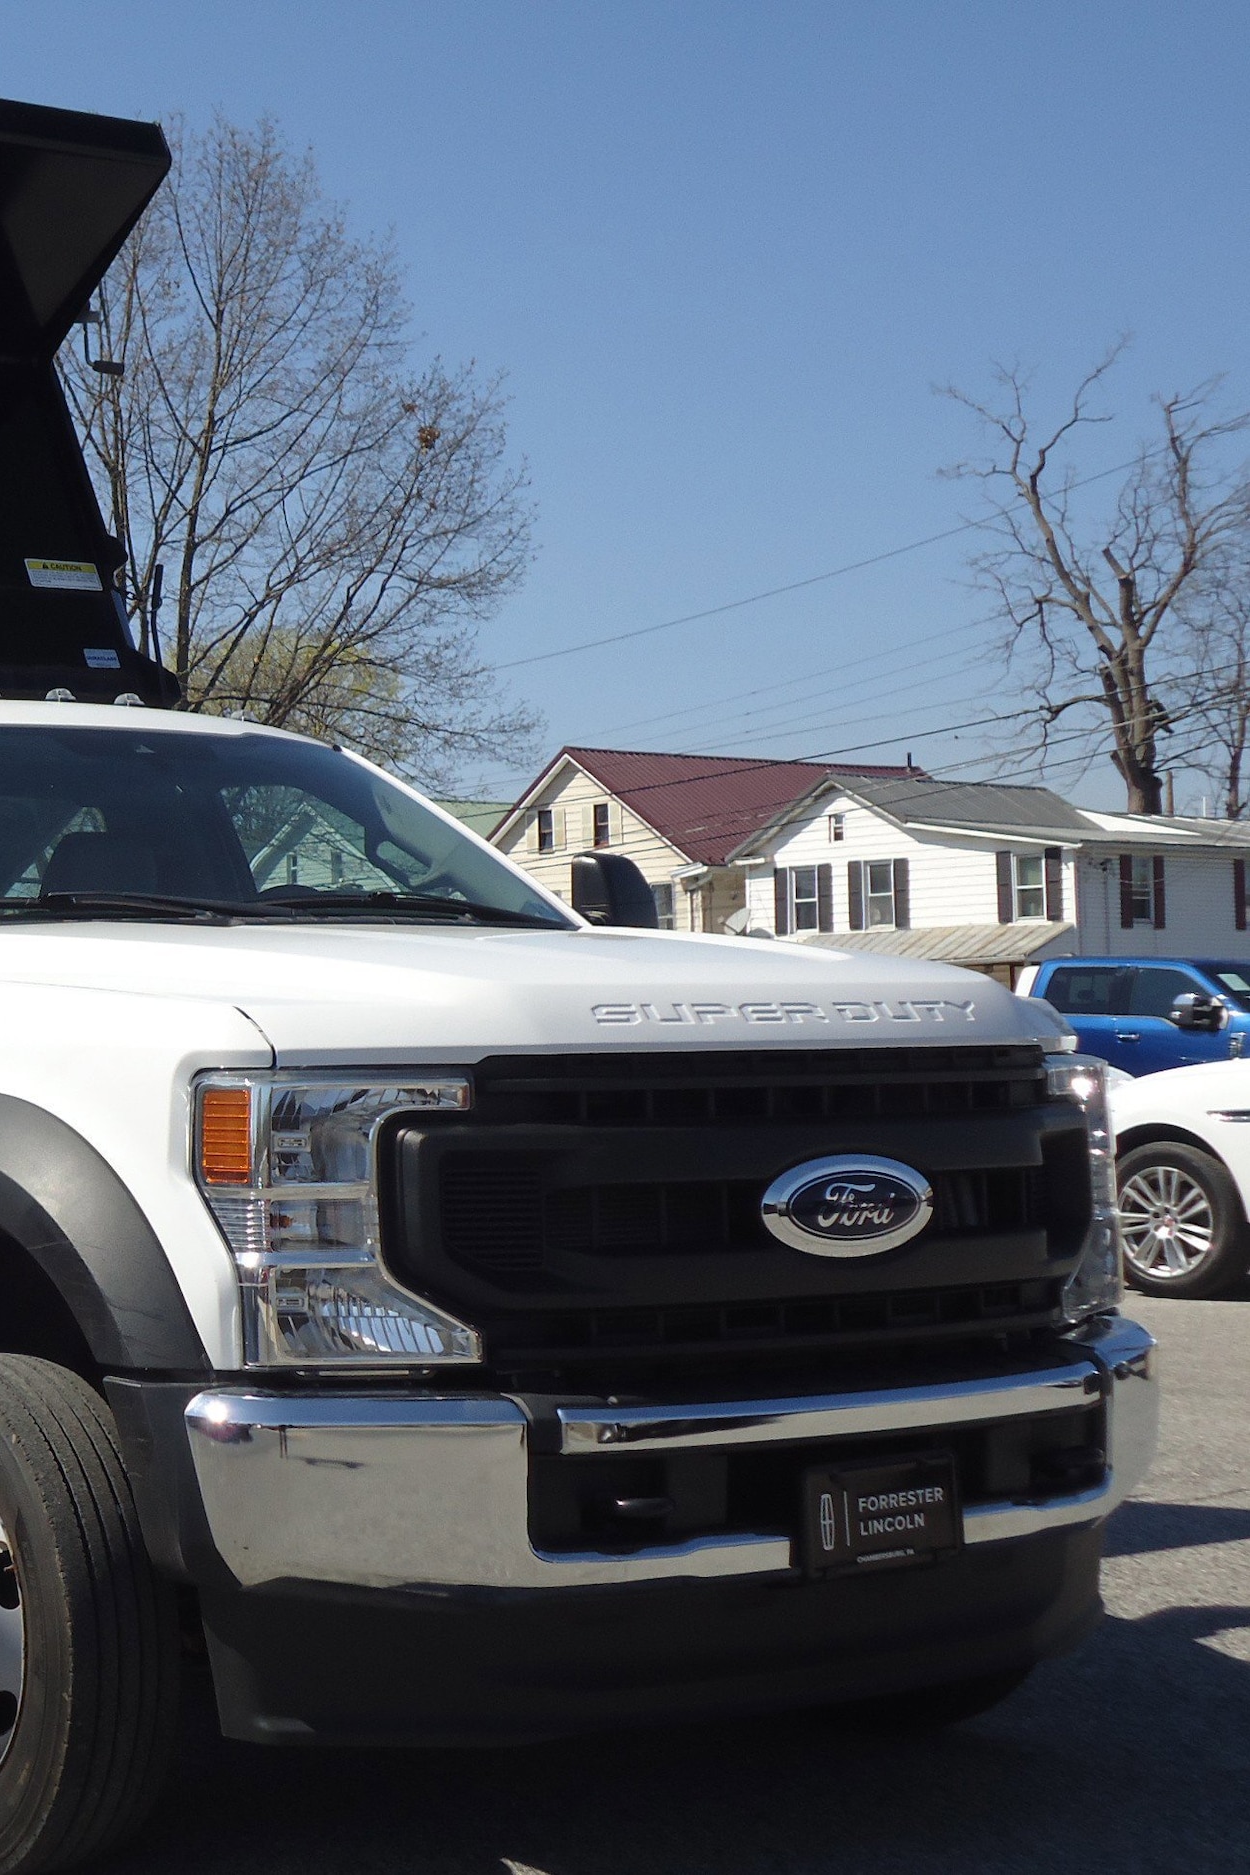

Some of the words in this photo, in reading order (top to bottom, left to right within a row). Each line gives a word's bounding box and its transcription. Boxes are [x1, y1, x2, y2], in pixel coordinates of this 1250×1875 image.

[50, 562, 83, 572] CAUTION
[591, 1001, 829, 1025] SUPER
[832, 1000, 976, 1023] DUTY
[817, 1182, 896, 1228] Ford
[857, 1487, 944, 1513] FORRESTER
[859, 1513, 926, 1536] LINCOLN
